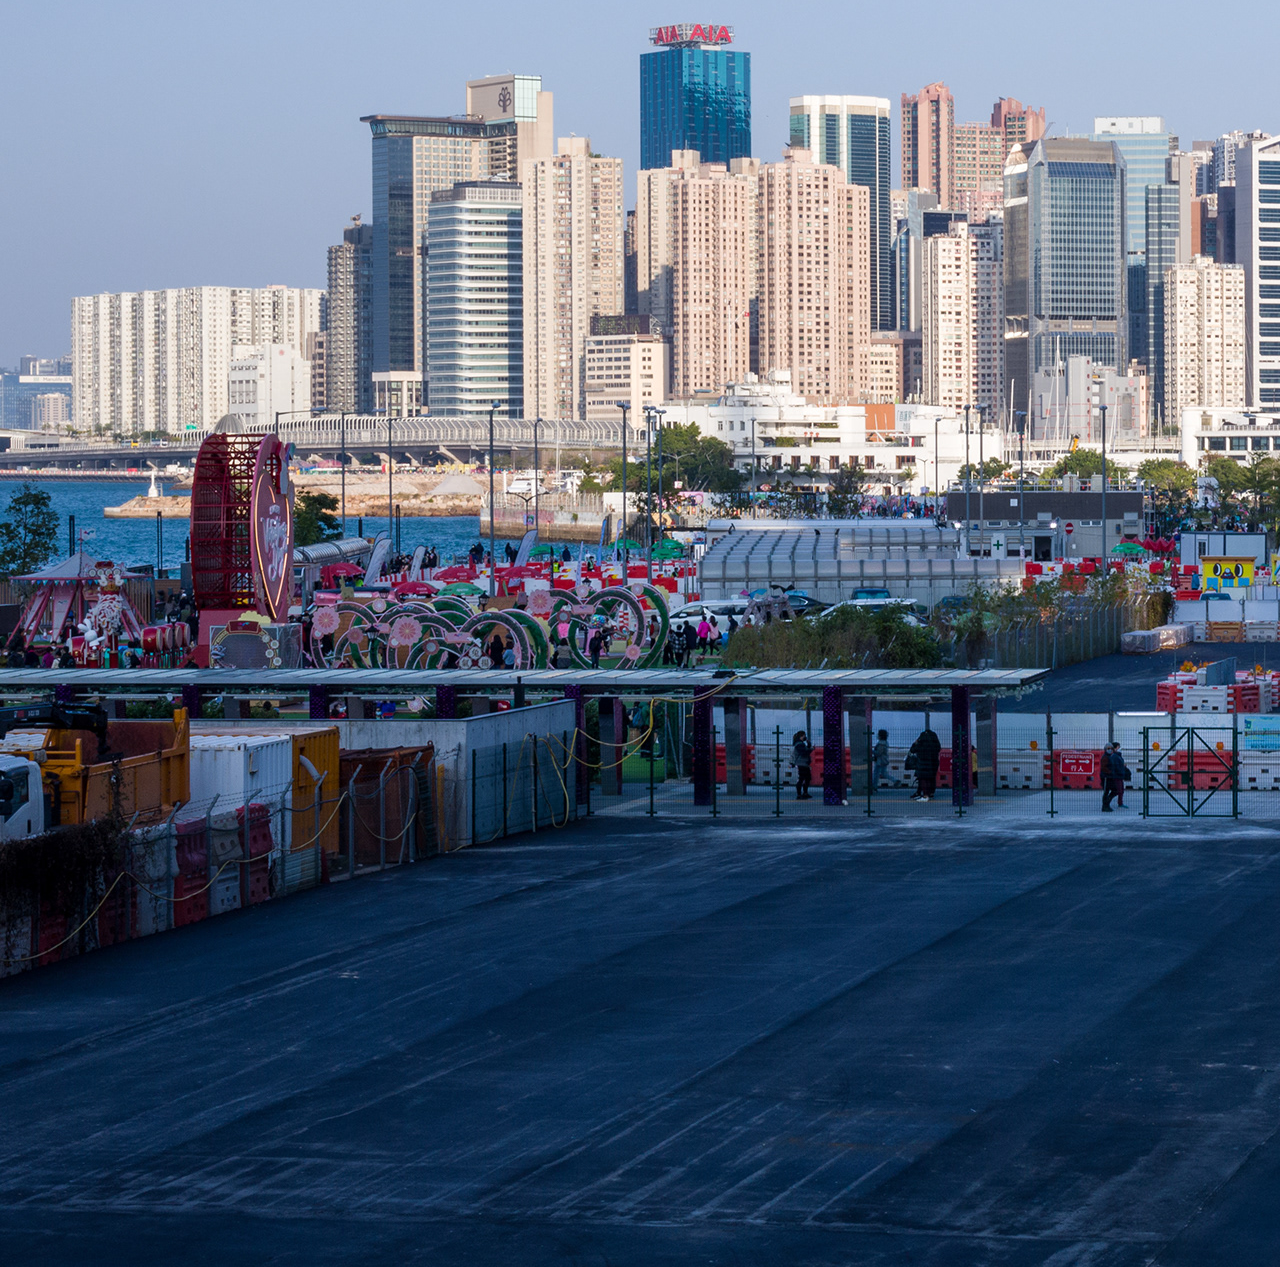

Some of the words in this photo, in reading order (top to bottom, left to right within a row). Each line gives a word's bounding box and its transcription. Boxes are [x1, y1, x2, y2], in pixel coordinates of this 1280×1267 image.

[656, 25, 680, 44] AIA
[689, 24, 732, 43] AIA
[1070, 764, 1084, 772] 行人
